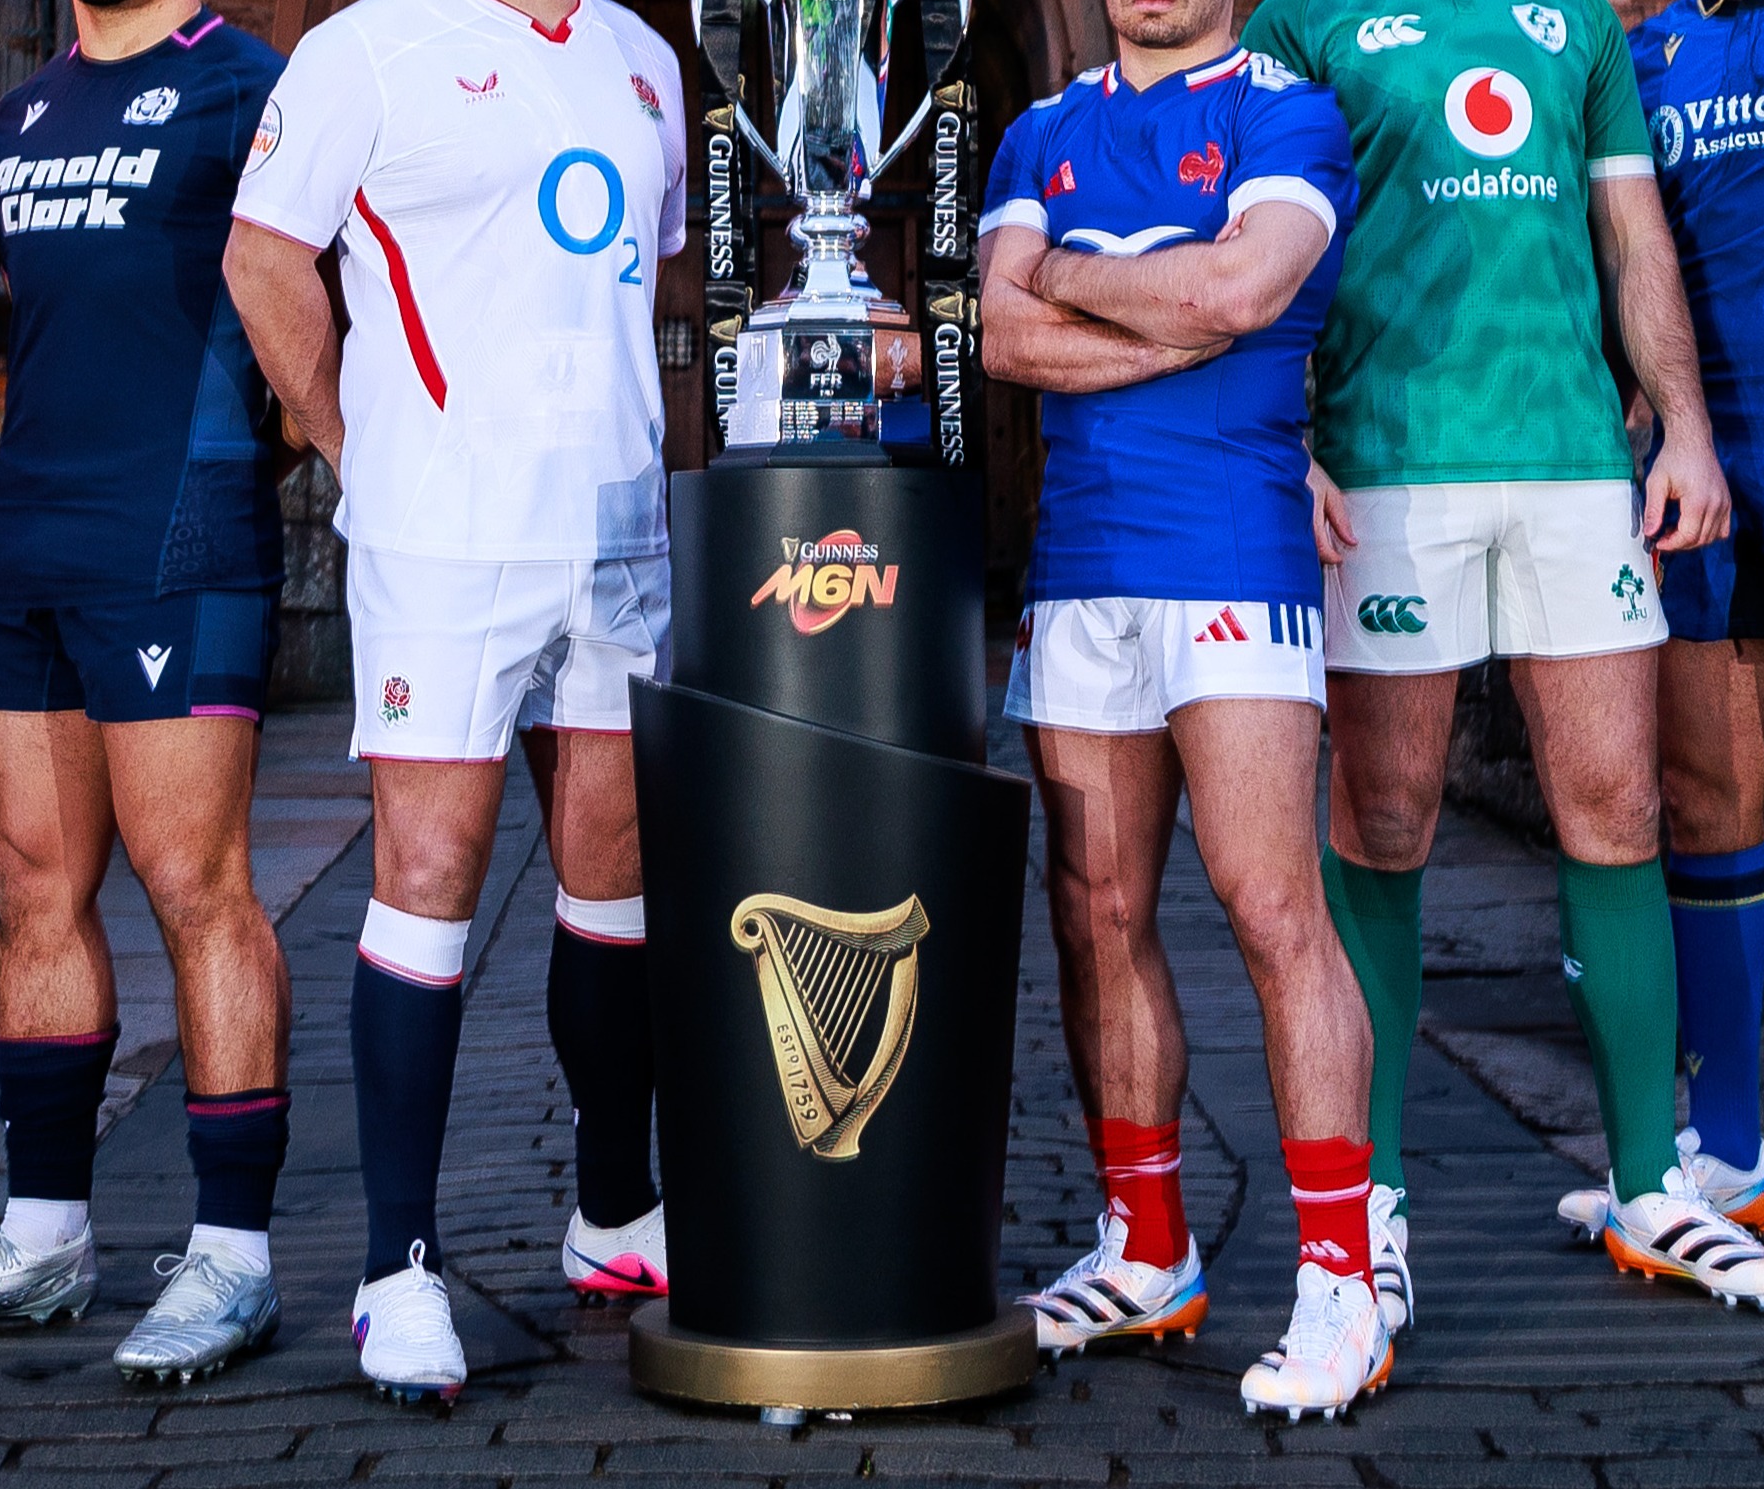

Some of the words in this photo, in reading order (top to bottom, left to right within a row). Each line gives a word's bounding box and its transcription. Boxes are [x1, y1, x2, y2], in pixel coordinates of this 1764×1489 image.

[708, 133, 734, 279] GUINNESS
[933, 111, 961, 257] GUINNESS
[1422, 166, 1558, 202] vodafone
[1, 188, 129, 237] Clark
[809, 373, 843, 388] FFR
[935, 322, 964, 466] GUINNESS
[800, 541, 879, 562] GUINNESS
[1621, 606, 1648, 622] IRFU
[787, 1070, 819, 1121] 1759
